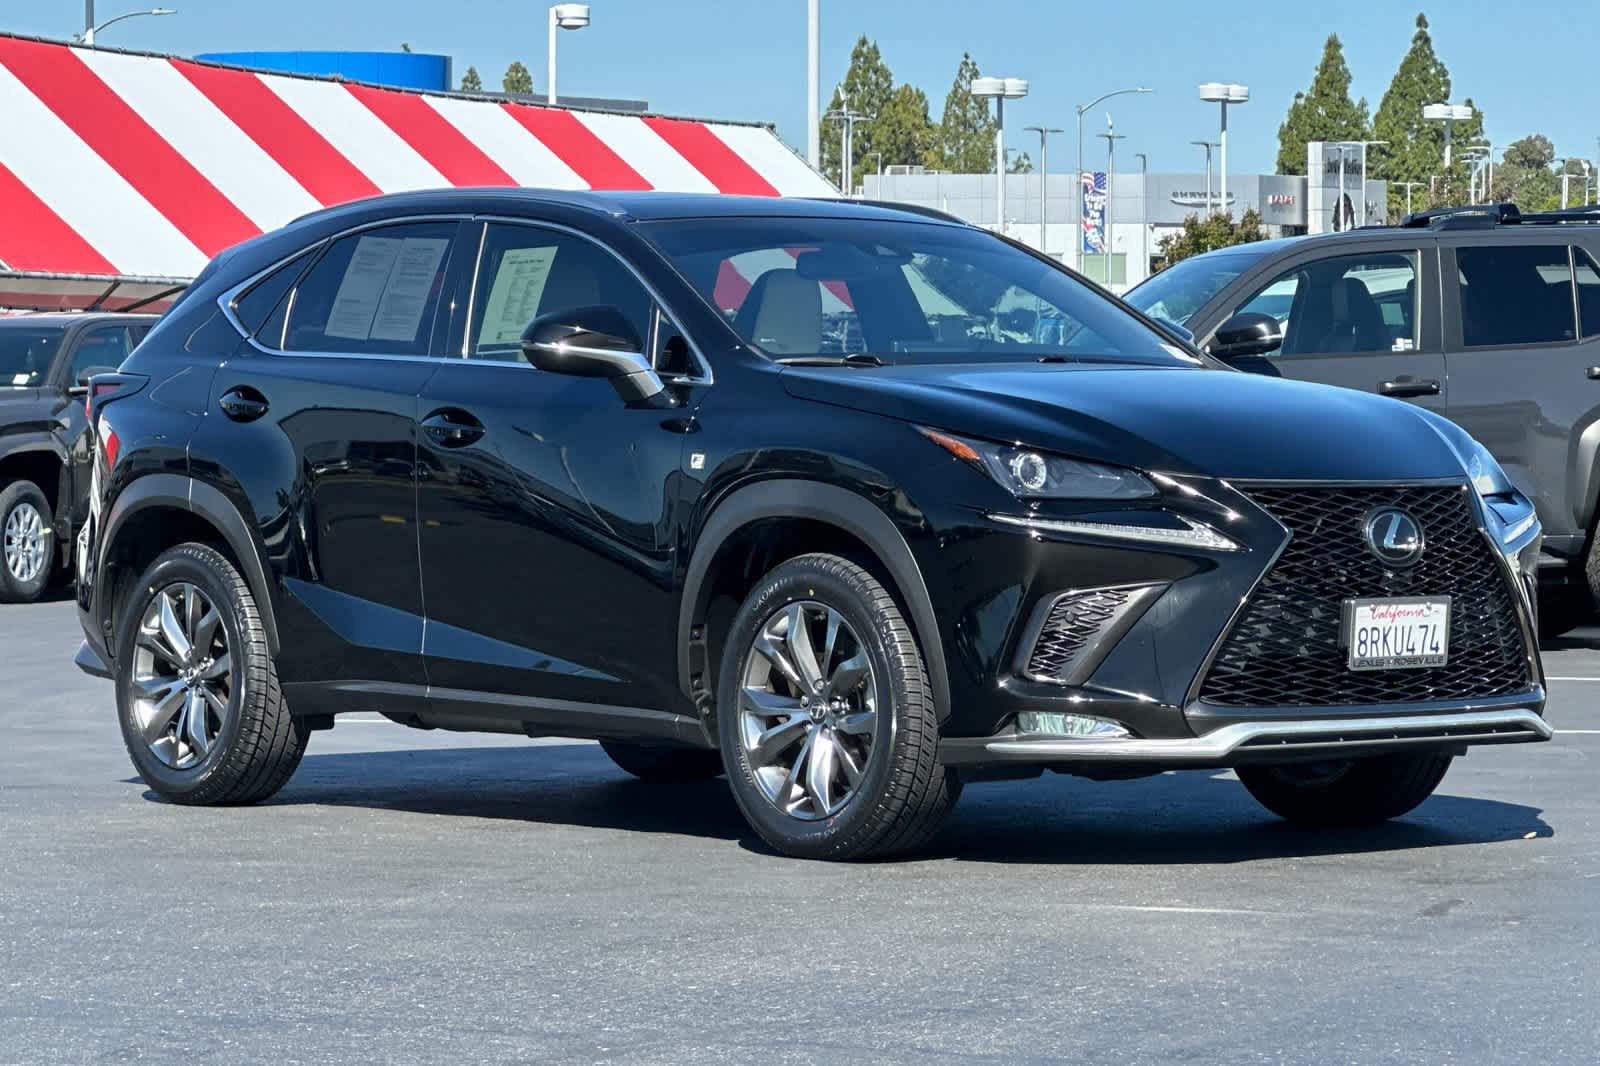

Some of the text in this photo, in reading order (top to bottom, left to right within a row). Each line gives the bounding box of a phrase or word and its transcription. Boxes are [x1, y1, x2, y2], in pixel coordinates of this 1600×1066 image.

[1370, 605, 1426, 623] California
[1357, 624, 1440, 657] 8RKU474
[1392, 655, 1443, 666] ROSEVILLE
